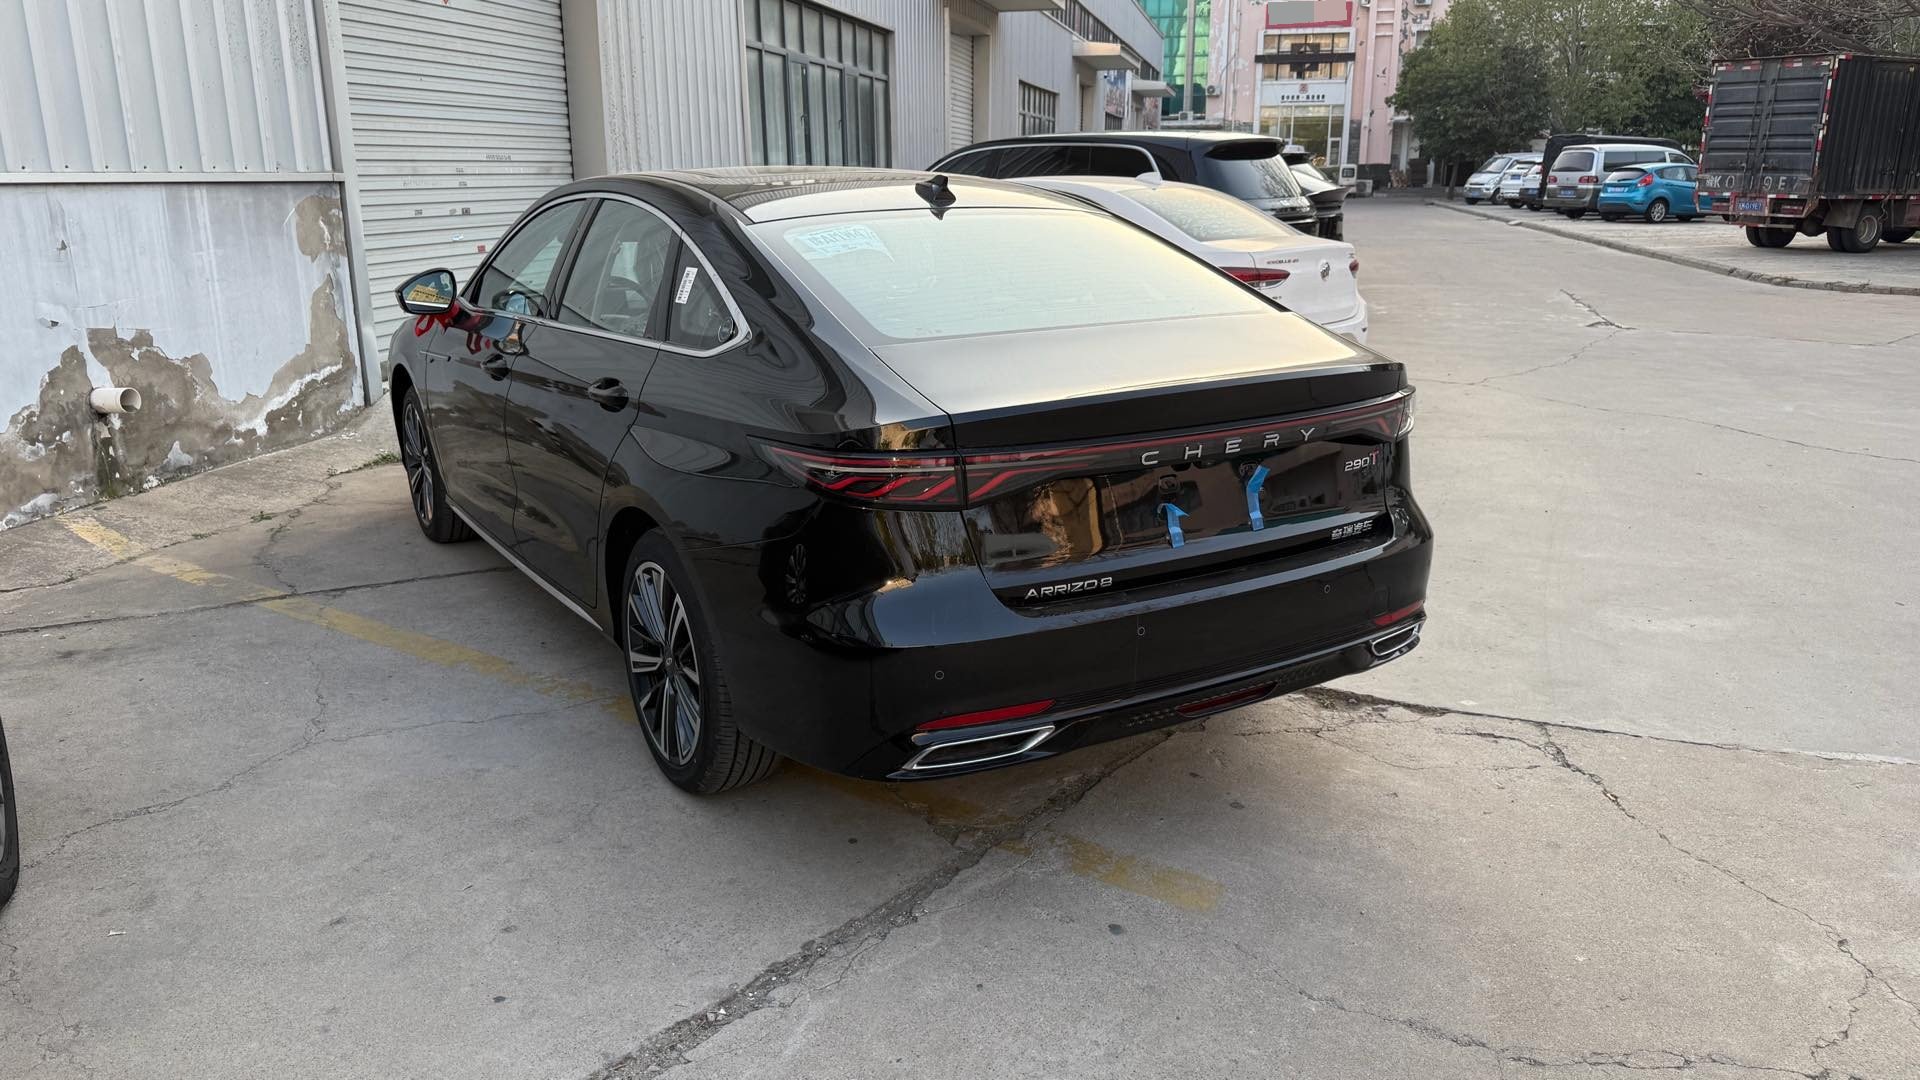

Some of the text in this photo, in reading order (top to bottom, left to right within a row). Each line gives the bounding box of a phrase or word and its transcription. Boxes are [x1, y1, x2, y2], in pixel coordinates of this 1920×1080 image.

[1141, 427, 1315, 466] CHERY
[1344, 448, 1380, 472] 290T
[1331, 519, 1373, 541] 奇瑞汽车
[1024, 579, 1098, 600] ARRIZO
